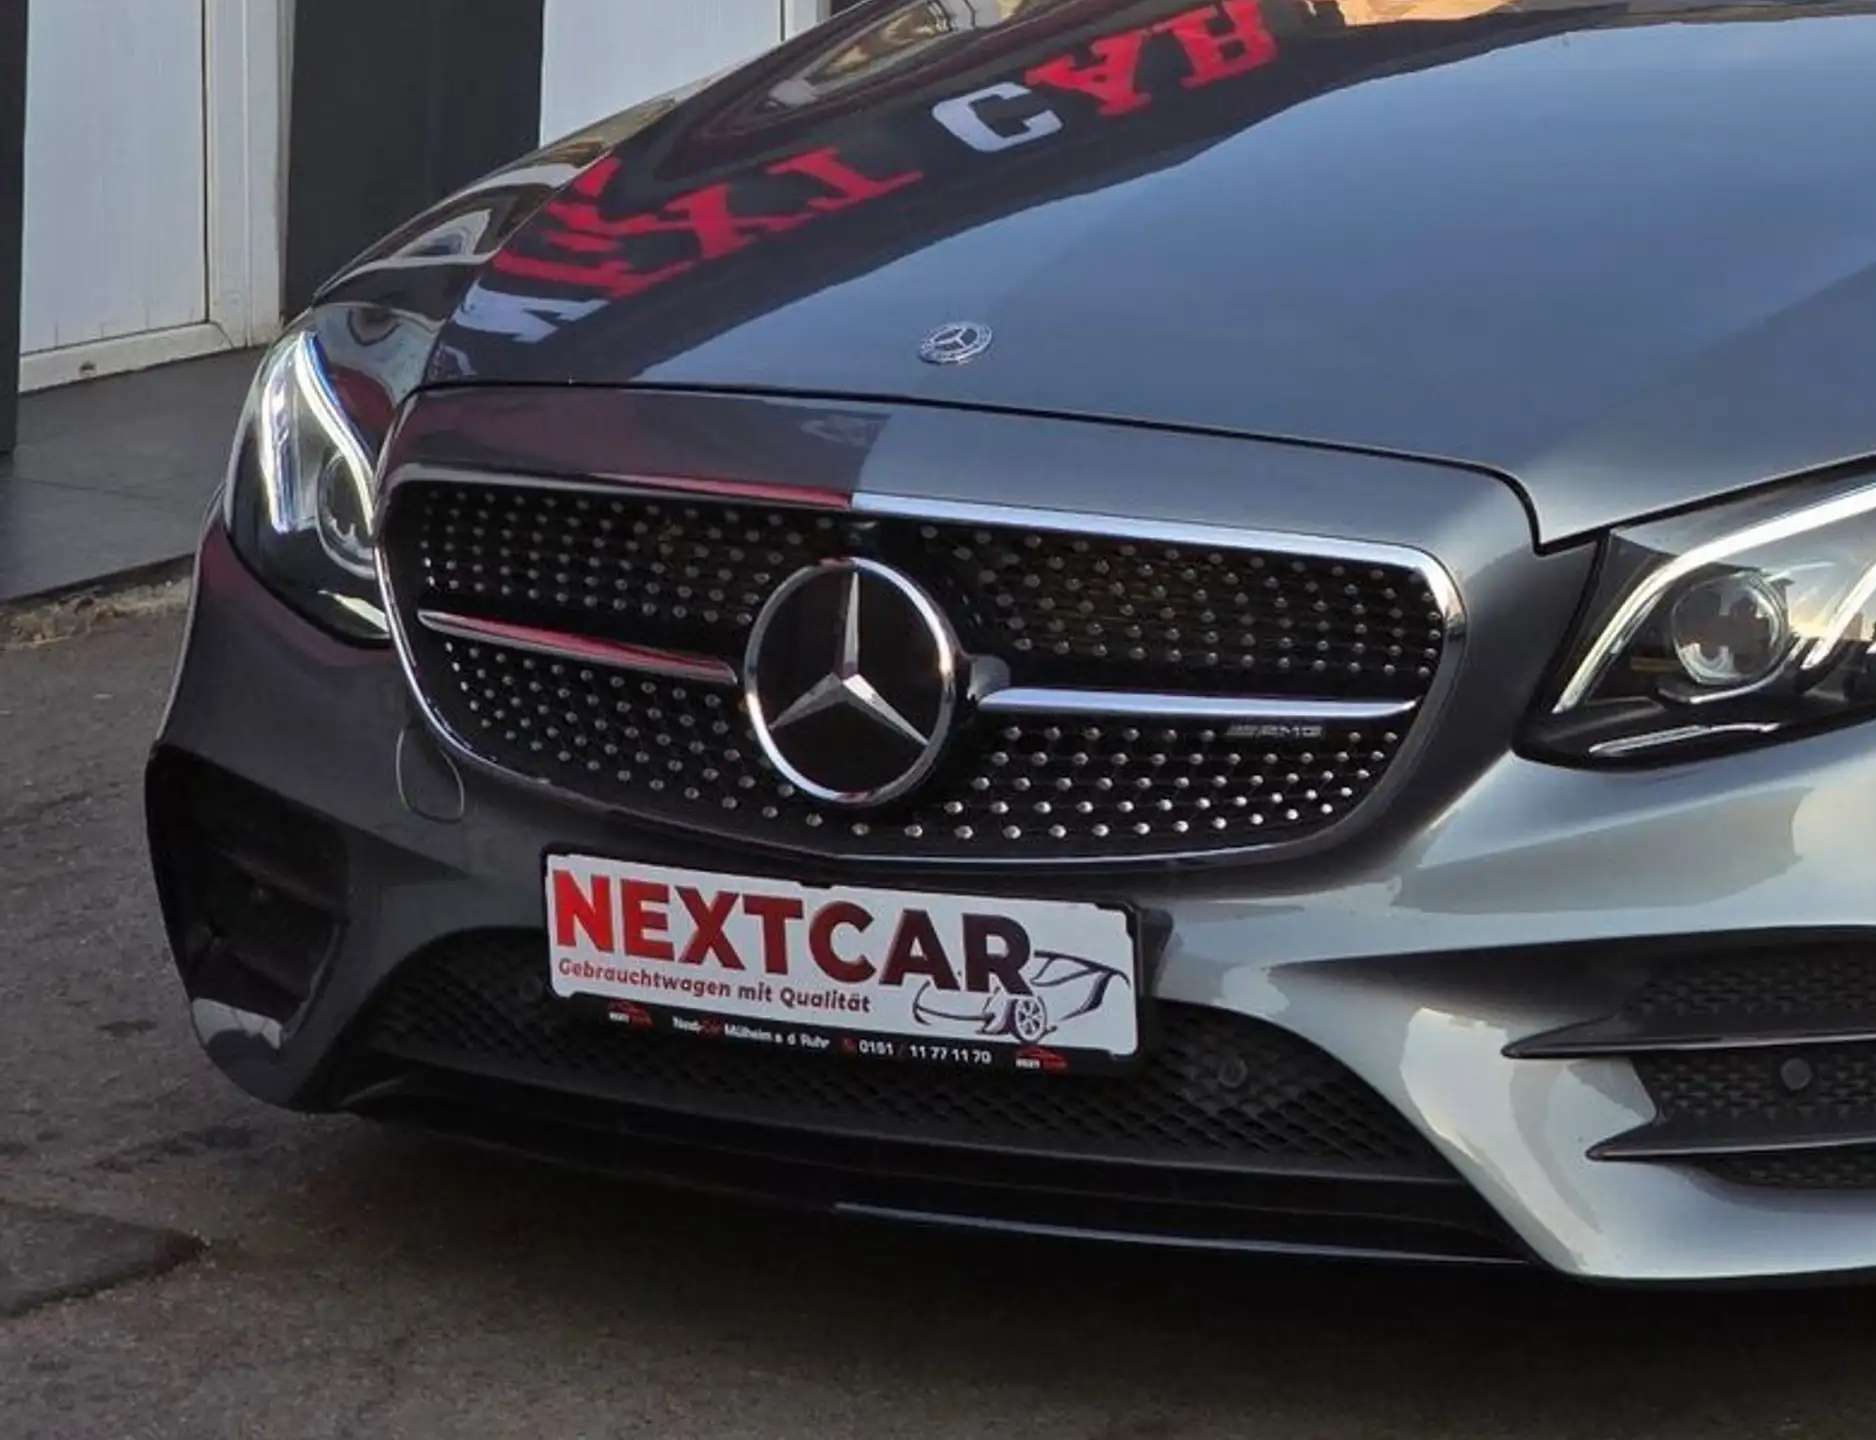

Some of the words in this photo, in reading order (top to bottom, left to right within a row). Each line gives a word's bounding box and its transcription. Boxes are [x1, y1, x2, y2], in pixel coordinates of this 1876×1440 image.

[553, 869, 1034, 996] NEXTCAR
[559, 957, 731, 997] Gebrauchtwagen
[738, 981, 773, 1003] mit
[780, 986, 871, 1013] Qualität
